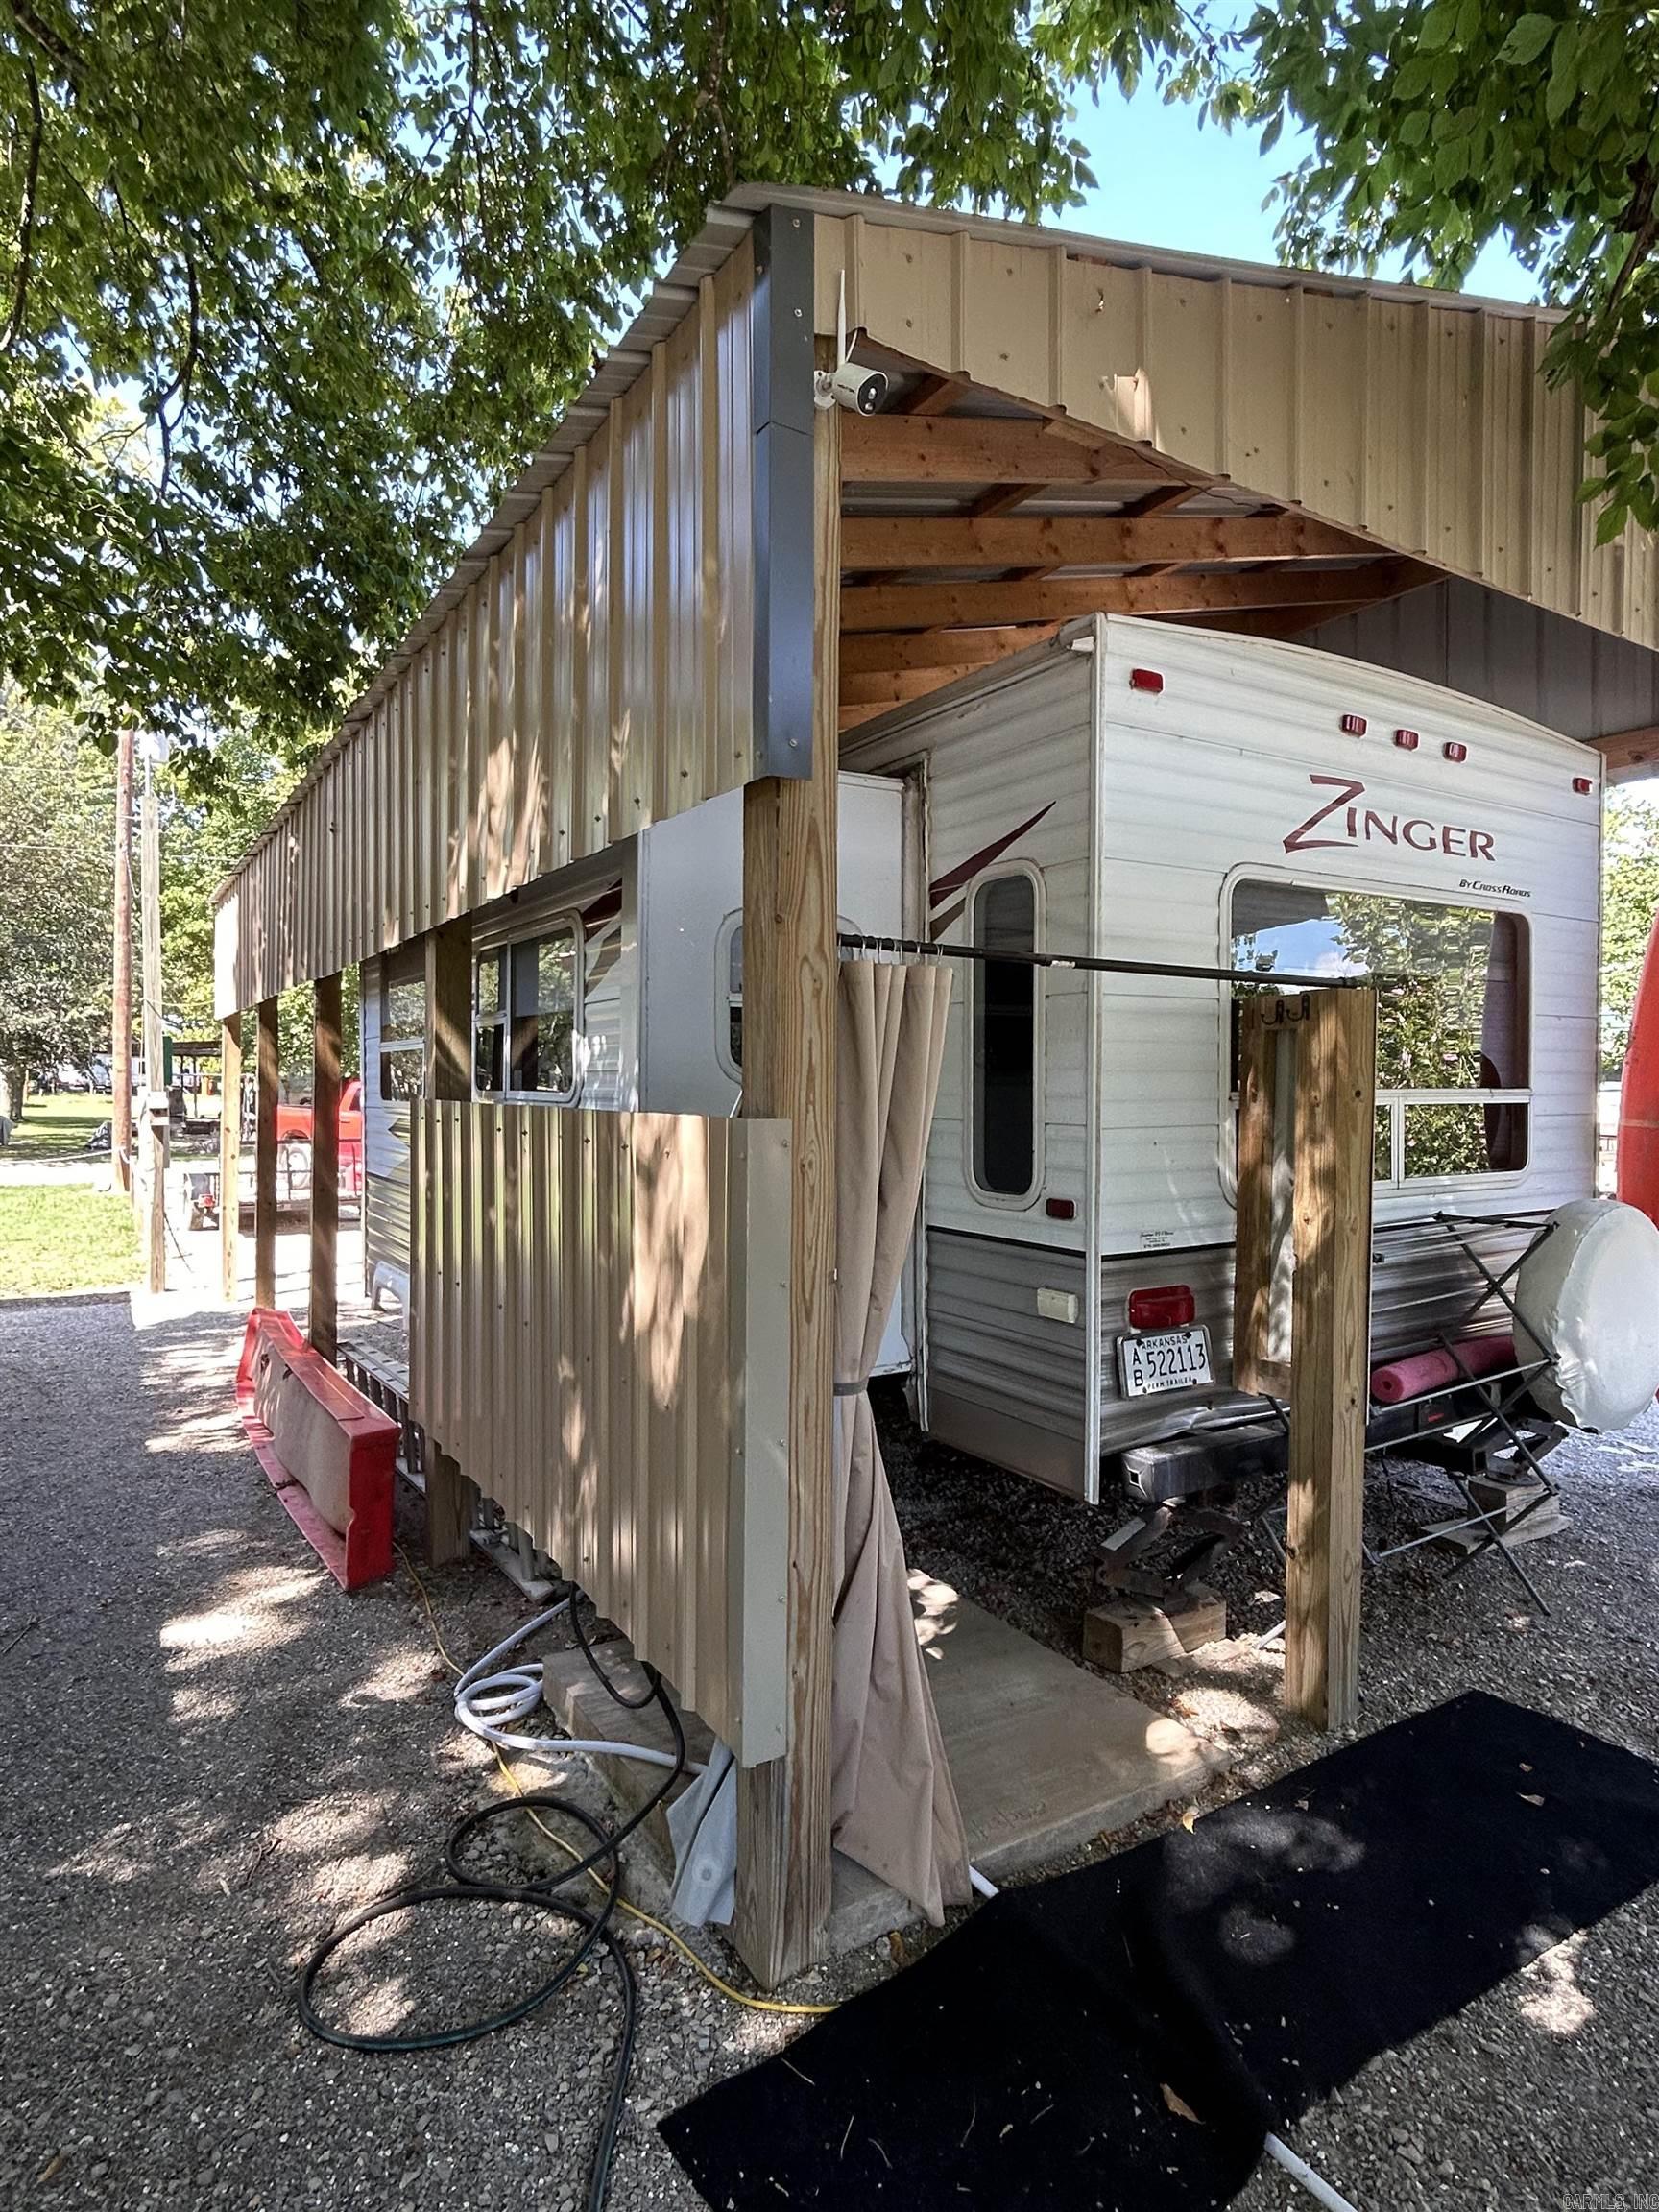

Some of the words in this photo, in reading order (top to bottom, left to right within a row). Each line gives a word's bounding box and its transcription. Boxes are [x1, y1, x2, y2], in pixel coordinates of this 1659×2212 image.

[1283, 774, 1496, 861] ZINGER
[1141, 1334, 1188, 1350] ARKANSAS
[1146, 1343, 1206, 1379] 522113
